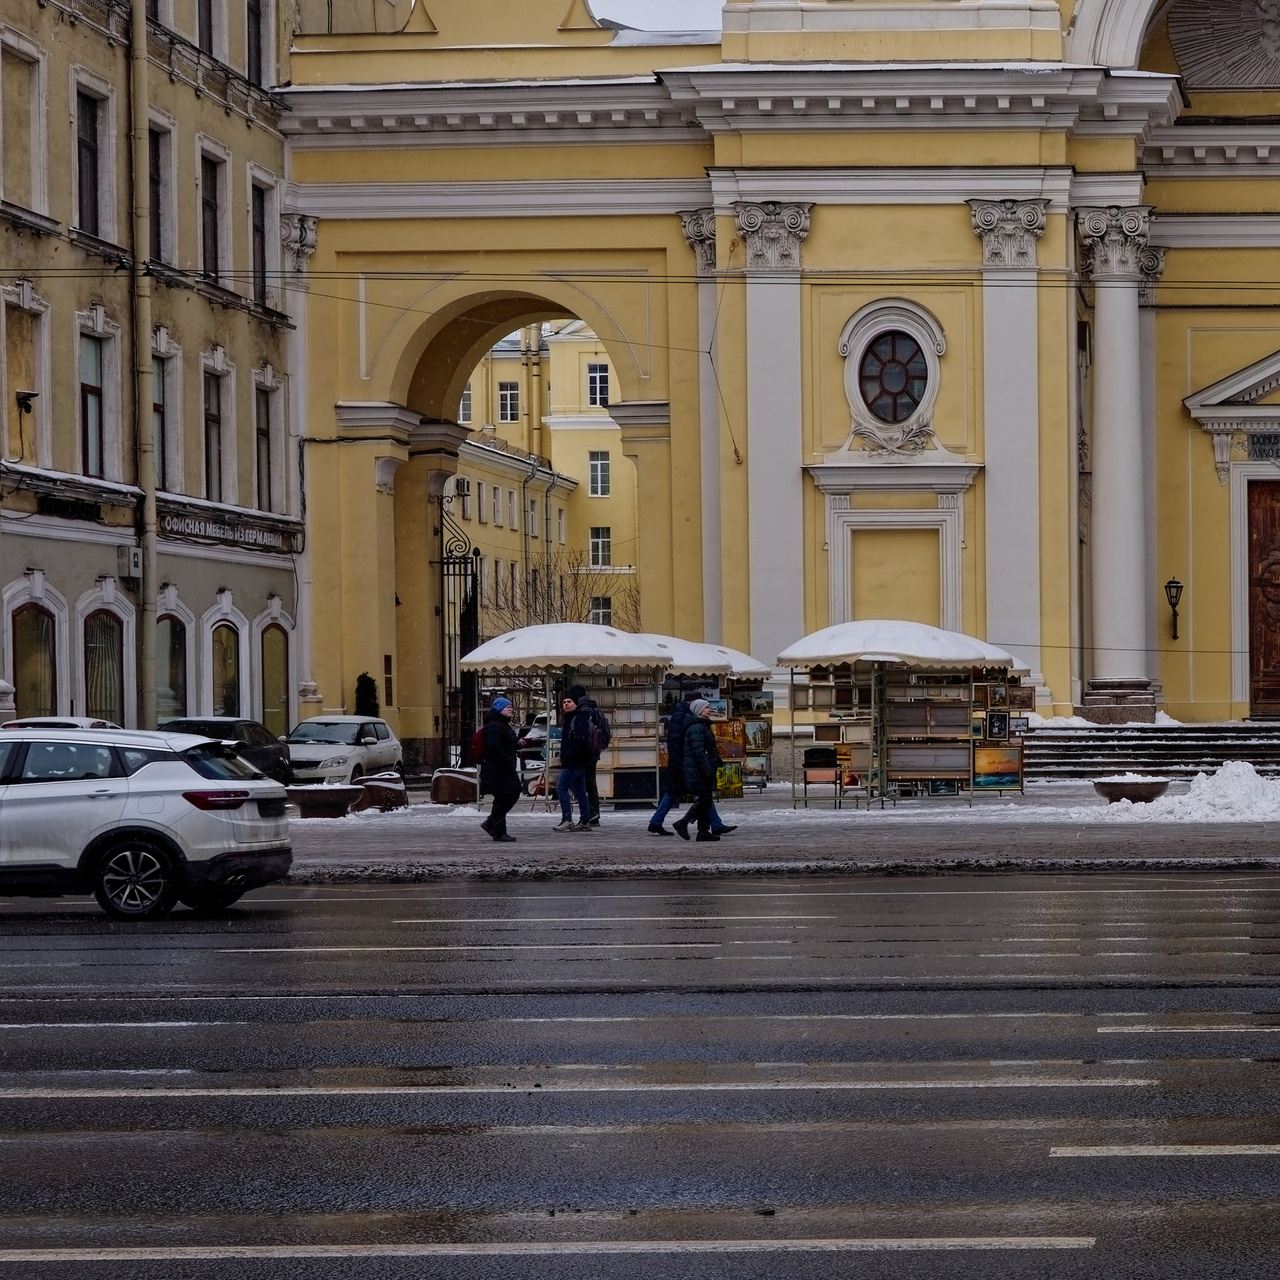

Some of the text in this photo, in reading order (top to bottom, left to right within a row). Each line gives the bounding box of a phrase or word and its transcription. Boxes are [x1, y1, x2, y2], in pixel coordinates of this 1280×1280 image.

[1252, 434, 1280, 445] DOMUS
[1252, 448, 1275, 458] ANNO
[165, 515, 283, 547] ОФИСНАЯ МЕБЕЛЬ ИЗ ГЕРМАНИИ
